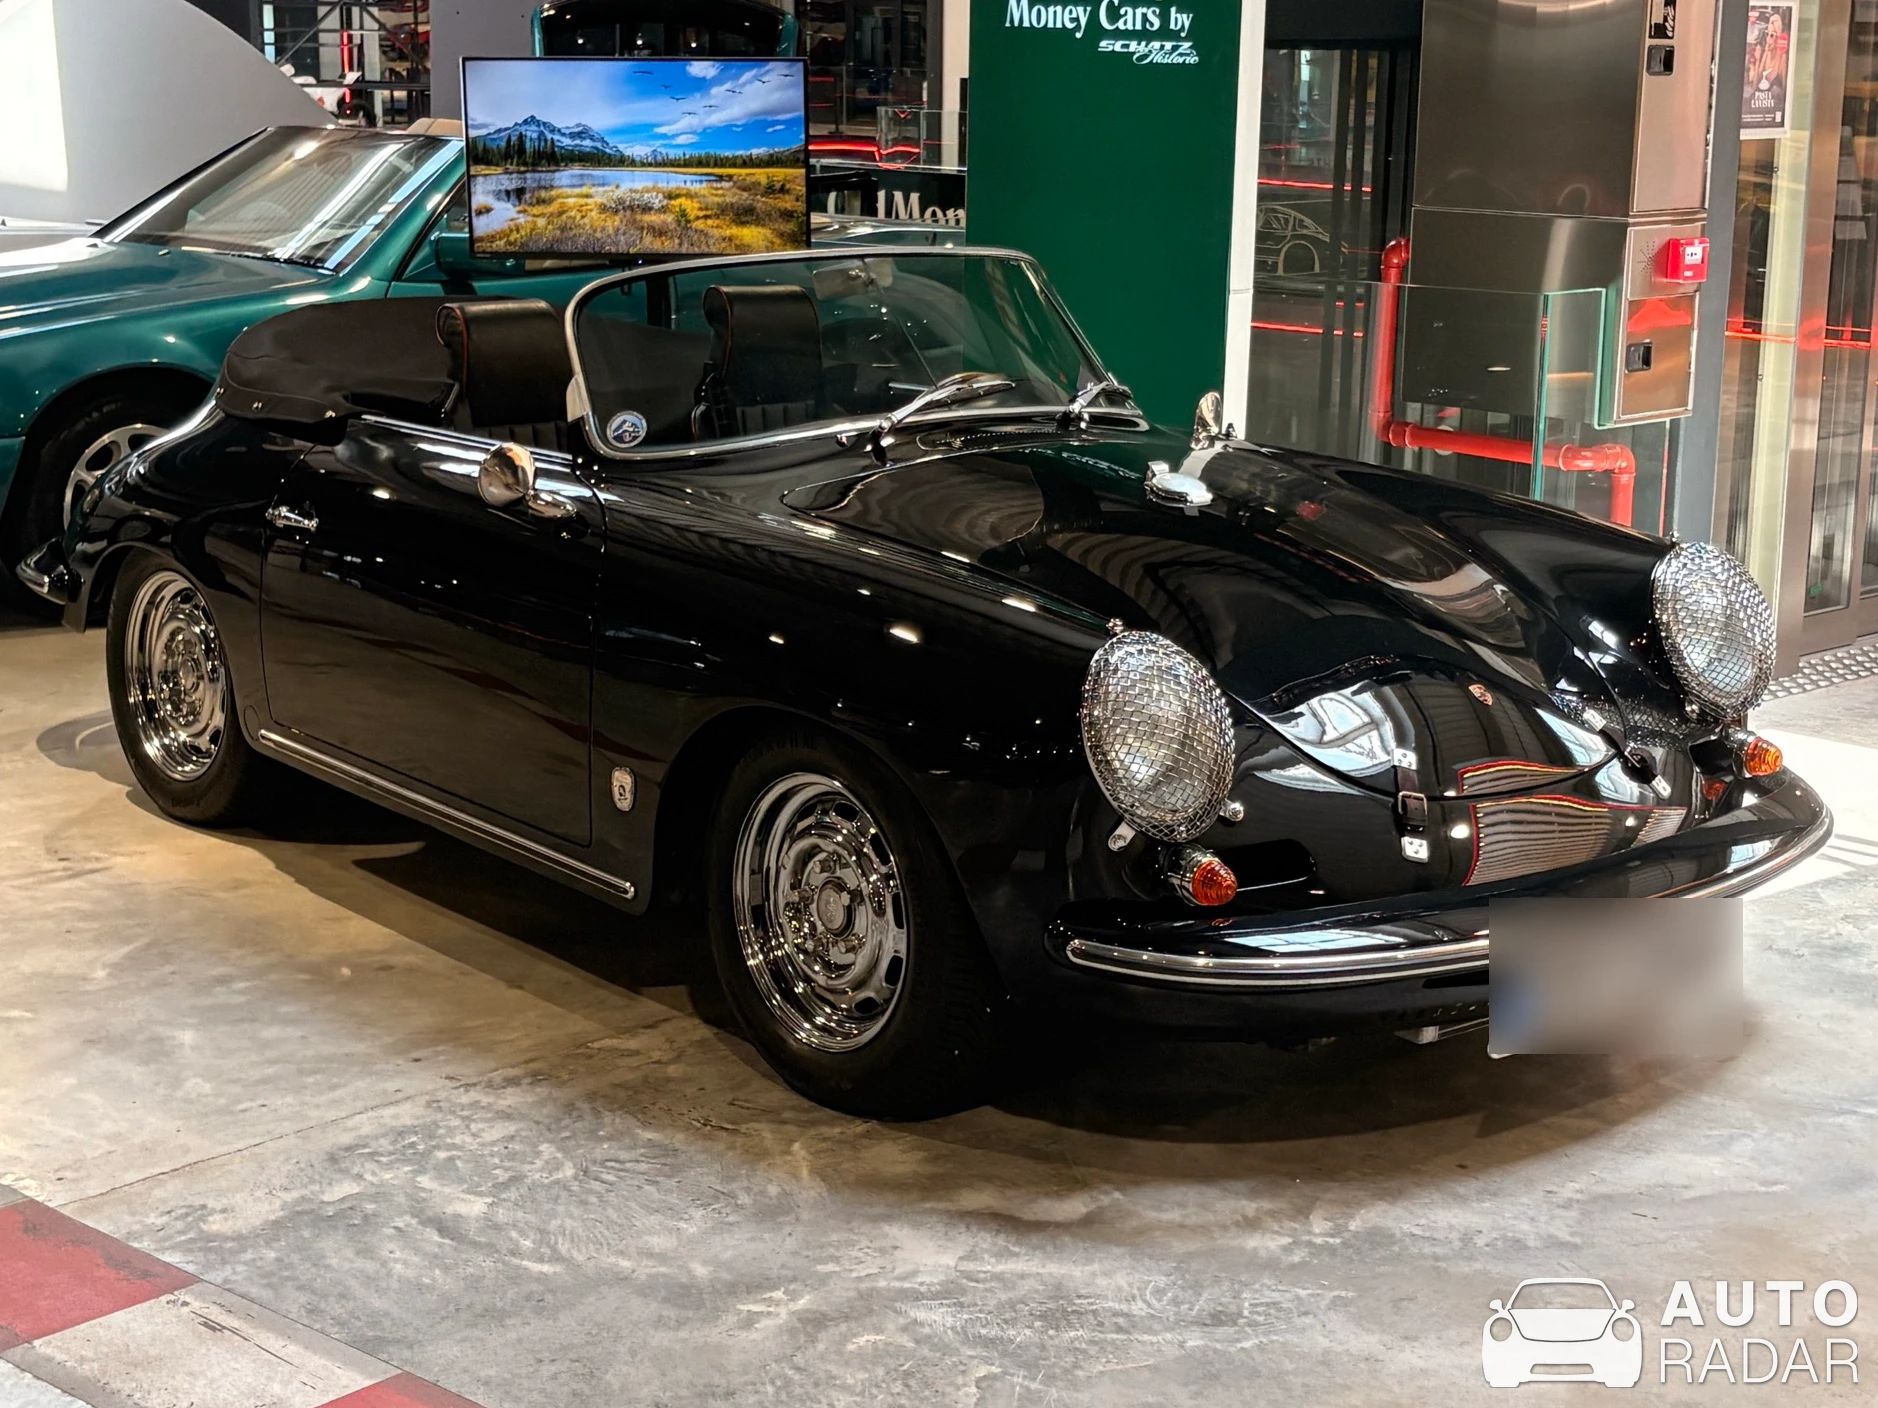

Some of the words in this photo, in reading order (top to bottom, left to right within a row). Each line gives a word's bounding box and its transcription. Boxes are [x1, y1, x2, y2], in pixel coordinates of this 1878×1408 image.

[1005, 0, 1092, 38] Money
[1099, 0, 1161, 31] Cars
[1169, 7, 1194, 37] by
[1098, 40, 1193, 53] SCHATZ
[892, 191, 965, 228] Mon
